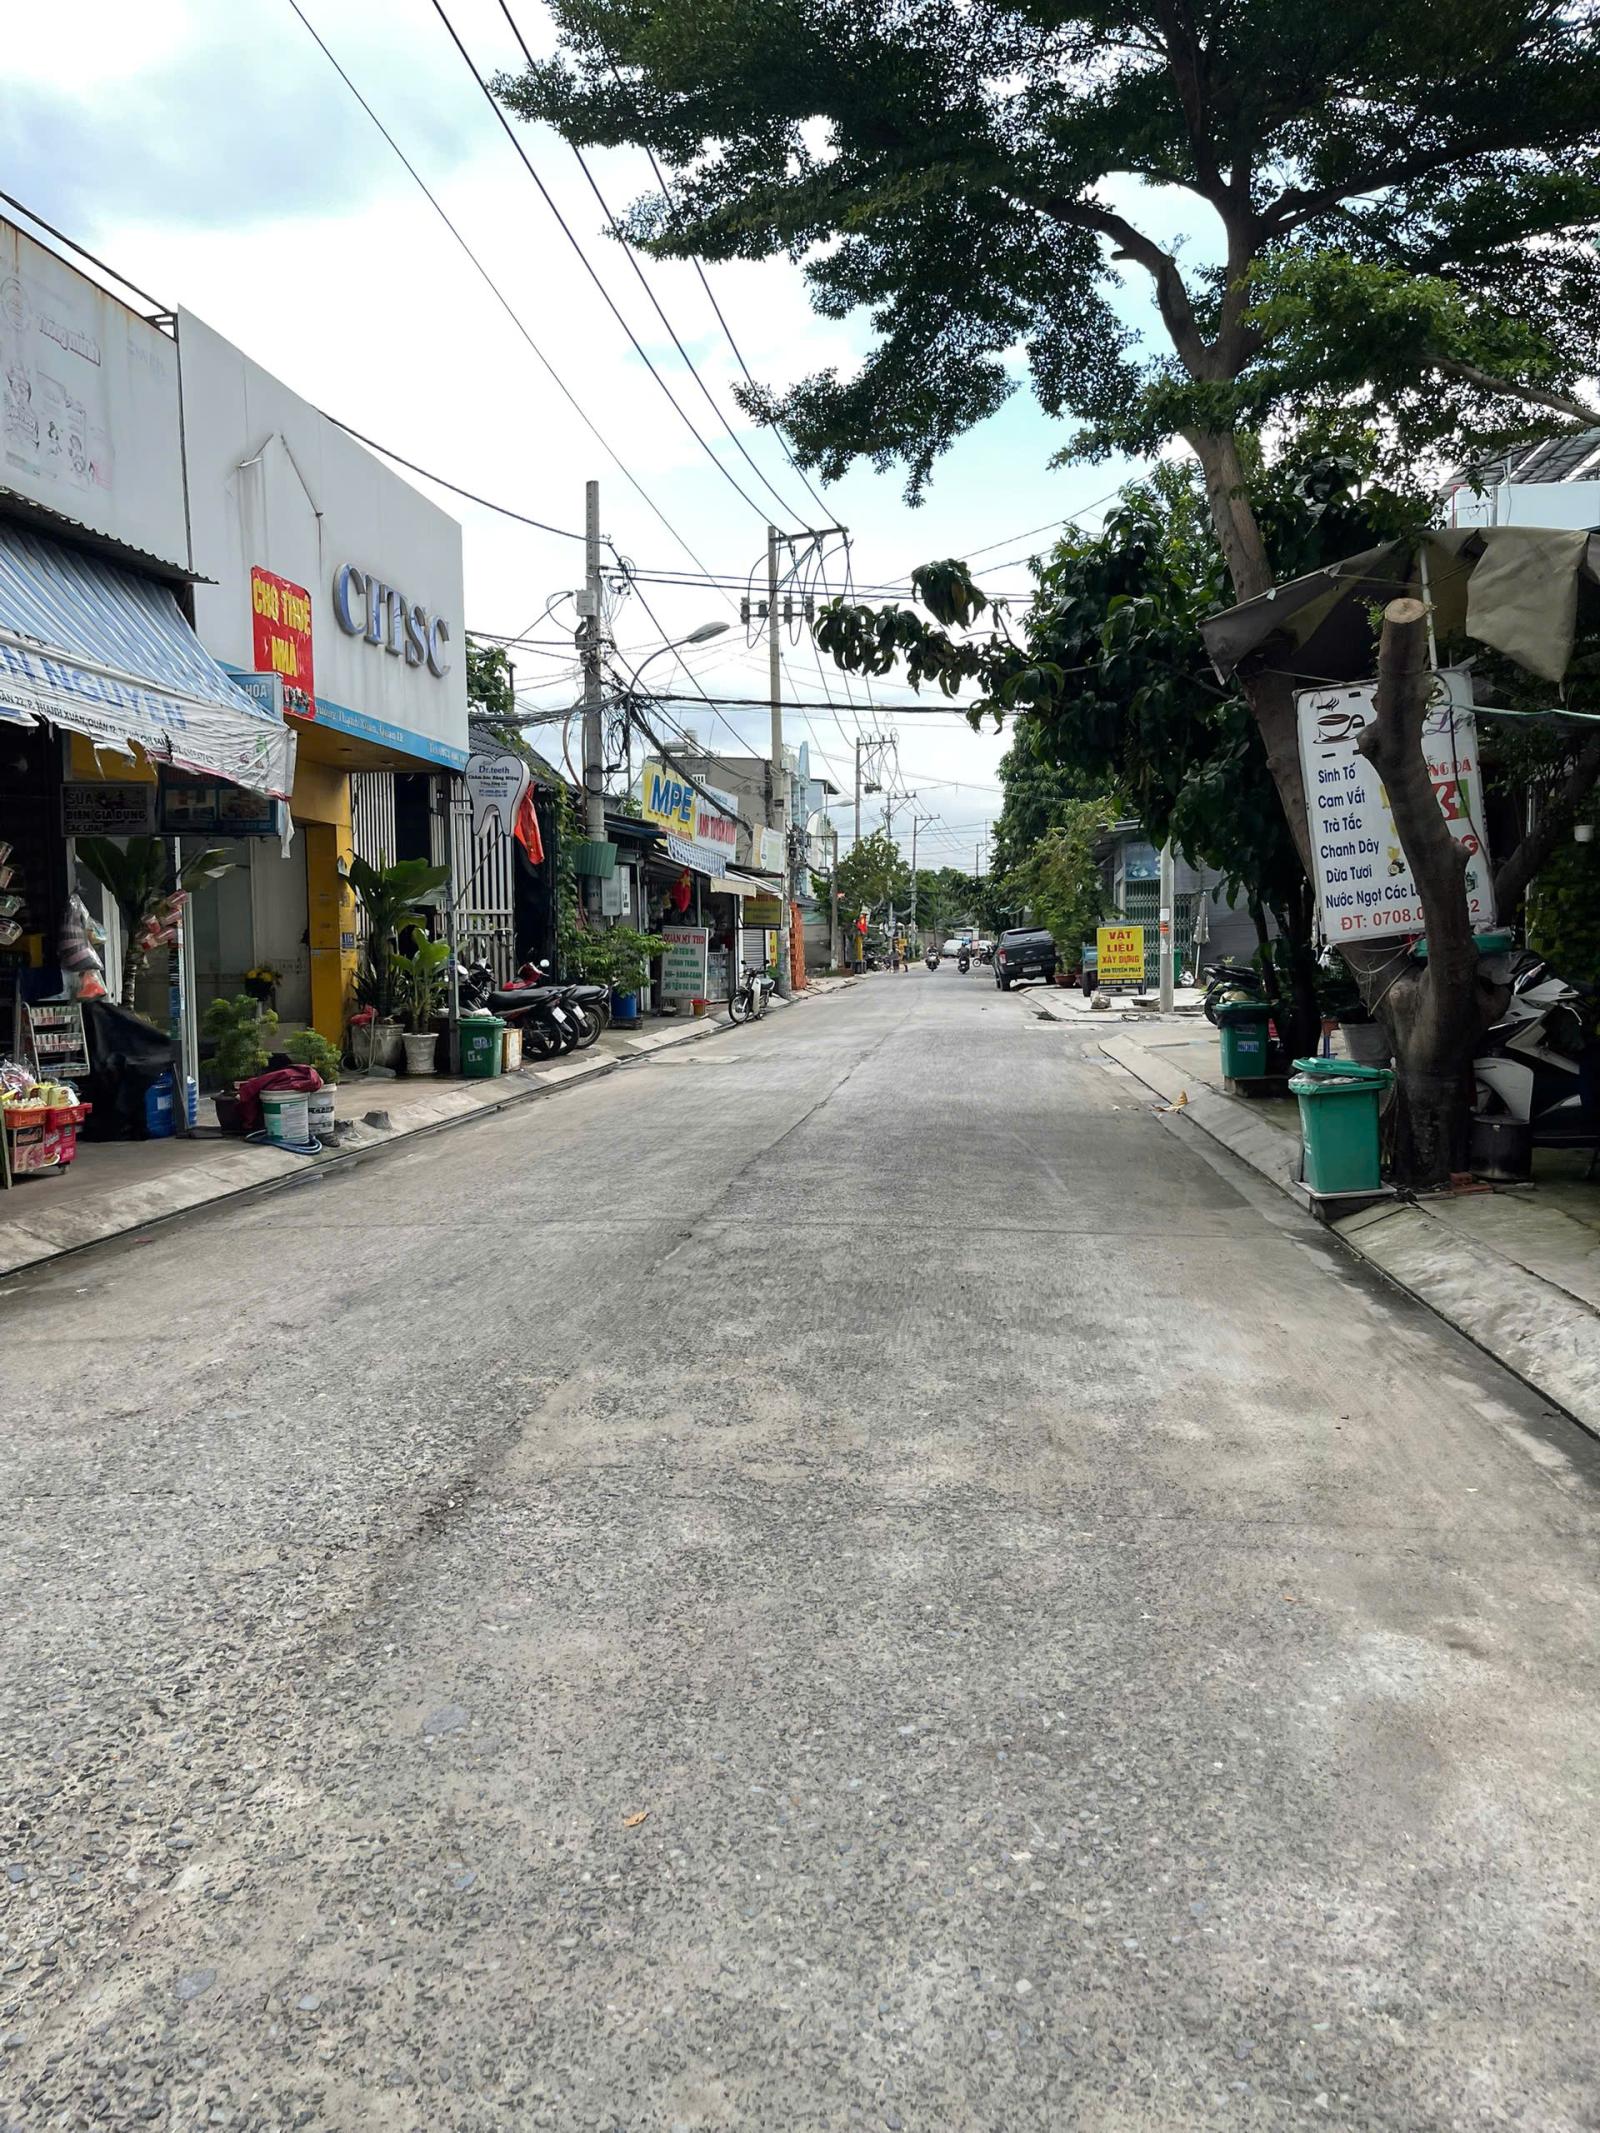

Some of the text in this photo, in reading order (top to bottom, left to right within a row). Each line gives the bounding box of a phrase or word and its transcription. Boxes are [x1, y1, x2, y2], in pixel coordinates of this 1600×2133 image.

[271, 636, 298, 678] NHÀ
[1318, 762, 1356, 784] Sinh Tố
[650, 774, 694, 821] MPE
[1318, 786, 1365, 809] Cam Vắt
[1323, 812, 1362, 833] Trà Tắc
[1321, 838, 1379, 859] Chanh Dây
[1327, 864, 1372, 883] Dừa Tươi
[1326, 892, 1353, 909] Nước
[1357, 888, 1381, 906] Ngọt
[1385, 884, 1407, 900] Các
[1341, 914, 1367, 930] ĐT:
